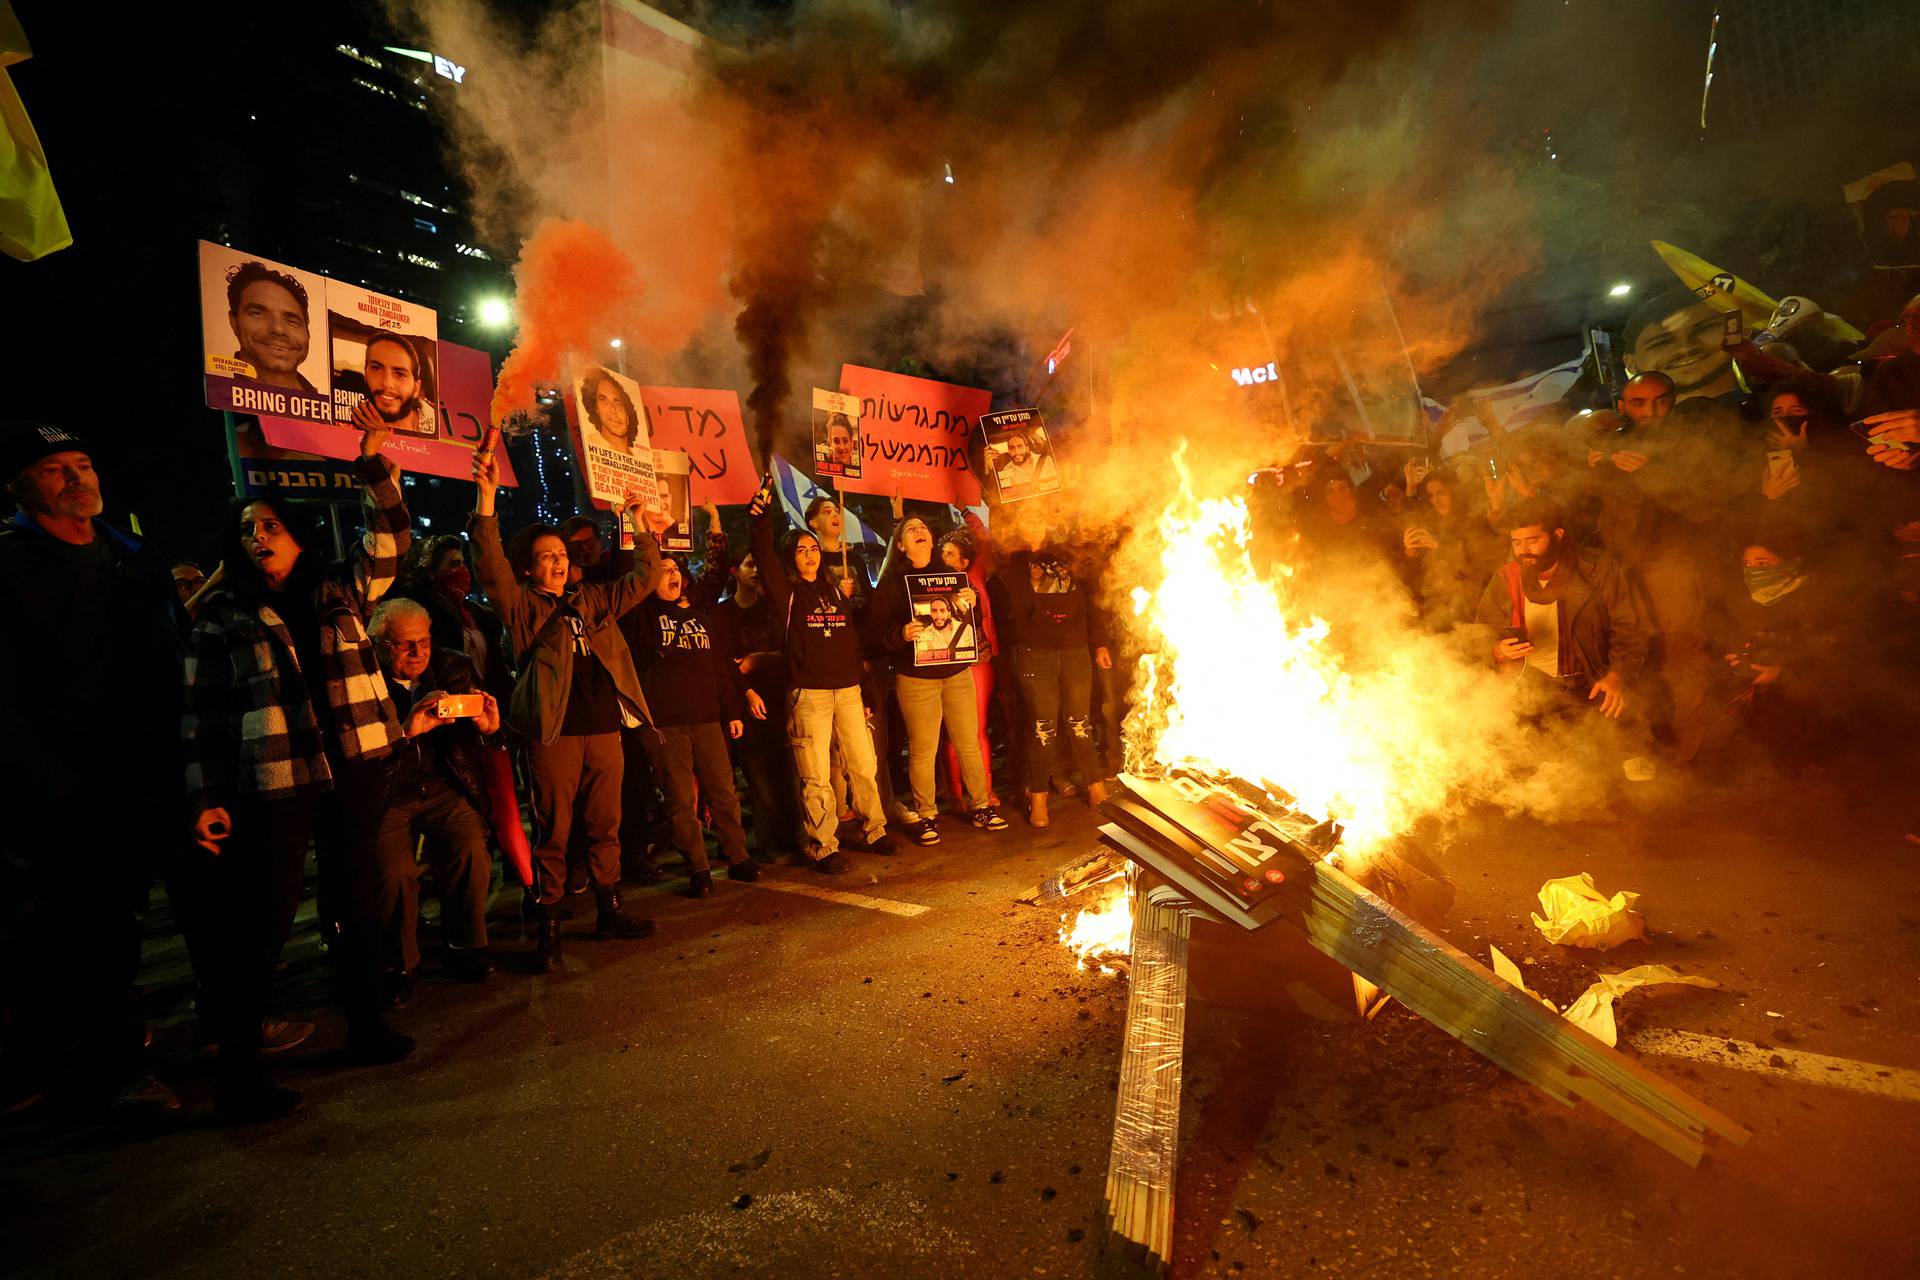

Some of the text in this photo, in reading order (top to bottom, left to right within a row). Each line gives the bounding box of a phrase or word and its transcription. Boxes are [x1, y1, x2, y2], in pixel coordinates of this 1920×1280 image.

[434, 54, 466, 84] EY
[358, 302, 378, 315] MATAN
[379, 307, 411, 324] ZANGAUKER
[215, 363, 228, 371] STILL
[231, 385, 331, 421] BRING OFER
[334, 388, 365, 407] BRING
[860, 393, 969, 437] מתגרשות
[588, 444, 599, 455] MY
[599, 447, 613, 459] LIFE
[622, 455, 634, 466] THE
[634, 458, 654, 472] HANDS
[860, 434, 970, 471] מהממשל
[601, 456, 622, 470] ISRAELI
[622, 463, 654, 479] GOVERNMENT
[248, 470, 327, 489] הבנים
[593, 471, 612, 484] THEY
[612, 476, 625, 488] ARE
[594, 480, 622, 496] DEATH
[918, 577, 927, 586] חי
